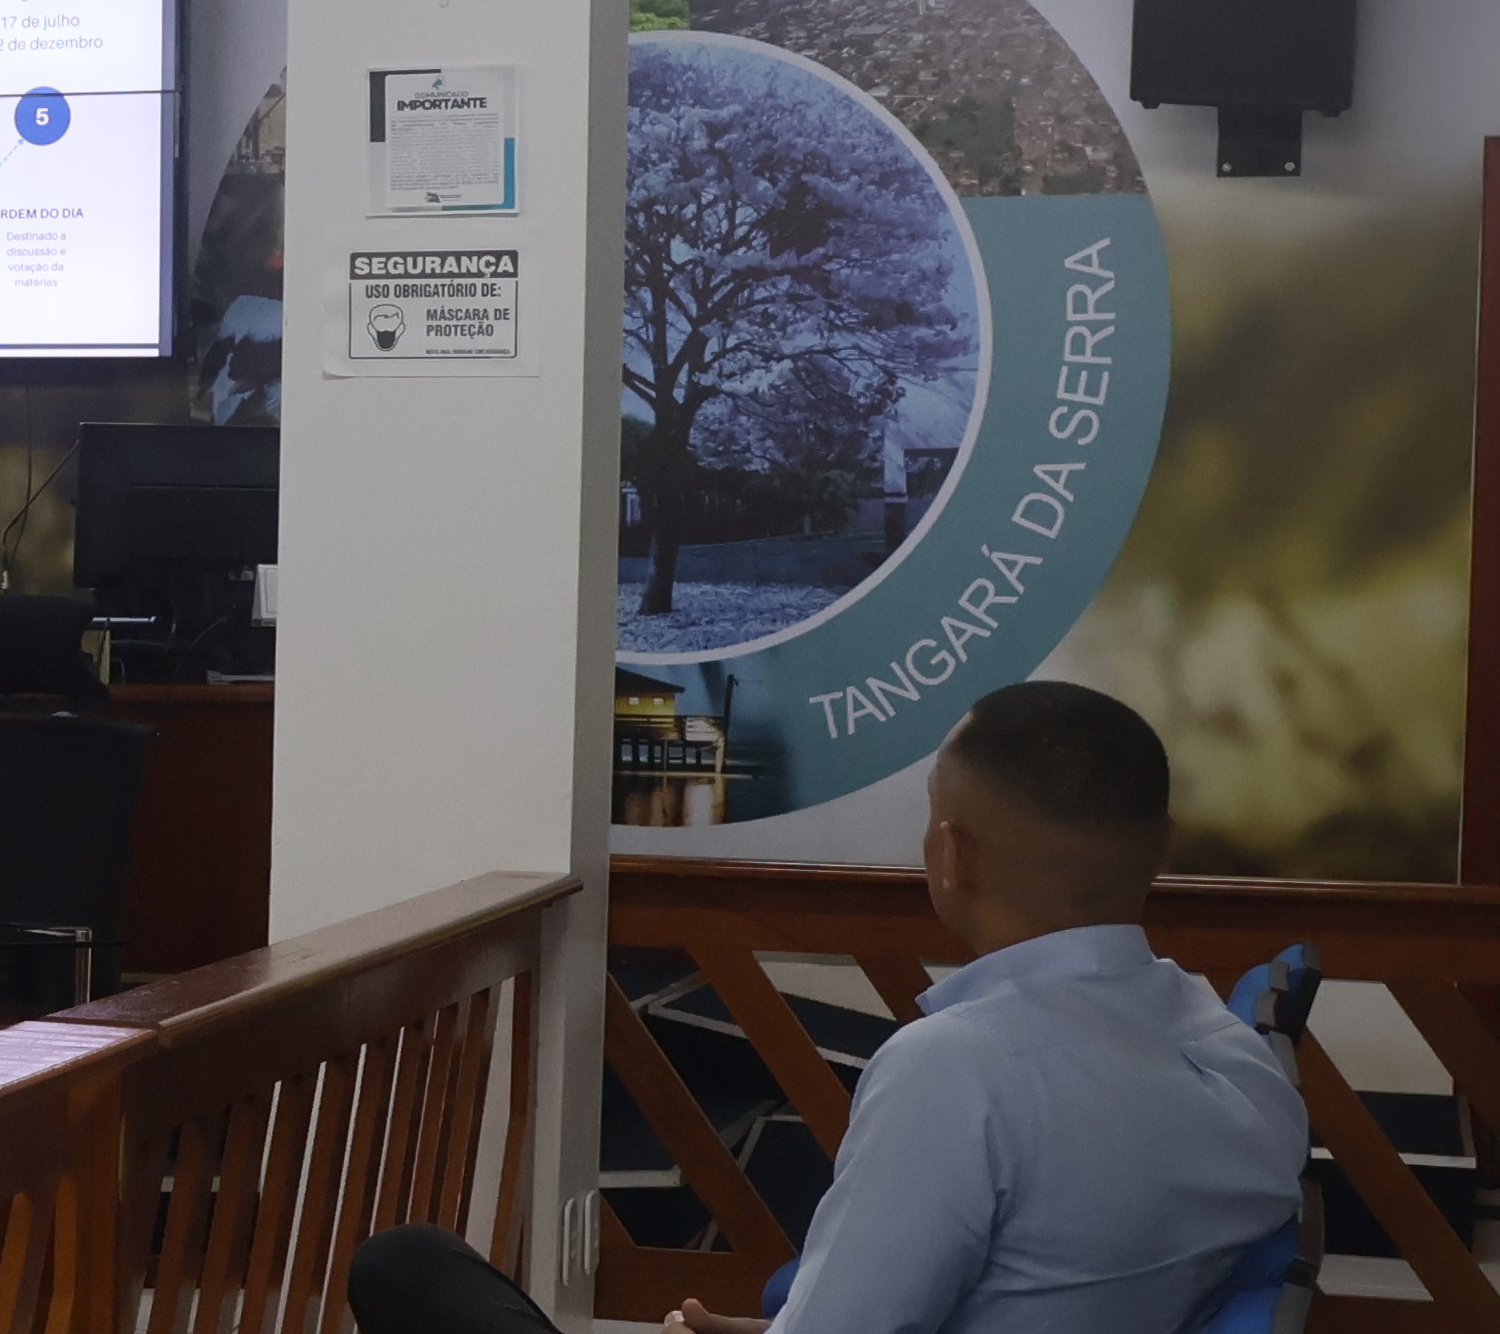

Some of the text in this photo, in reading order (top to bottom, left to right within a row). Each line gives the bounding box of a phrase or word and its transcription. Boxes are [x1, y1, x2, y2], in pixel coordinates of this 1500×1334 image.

[1, 16, 17, 28] 17
[22, 15, 39, 28] de
[44, 14, 80, 30] julho
[8, 38, 26, 51] de
[30, 35, 103, 50] dezembro
[398, 97, 486, 111] IMPORTANTE
[36, 107, 49, 125] 5
[40, 208, 59, 218] DO
[62, 208, 84, 218] DIA
[354, 255, 514, 278] SEGURANÇA
[366, 279, 502, 299] USO OBRIGATÓRIO DE:
[426, 306, 510, 321] MÁSCARA DE
[426, 322, 494, 339] PROTEÇÃO
[1048, 237, 1115, 447] SERRA
[1012, 461, 1084, 539] DA
[810, 543, 1044, 740] TANGARÁ
